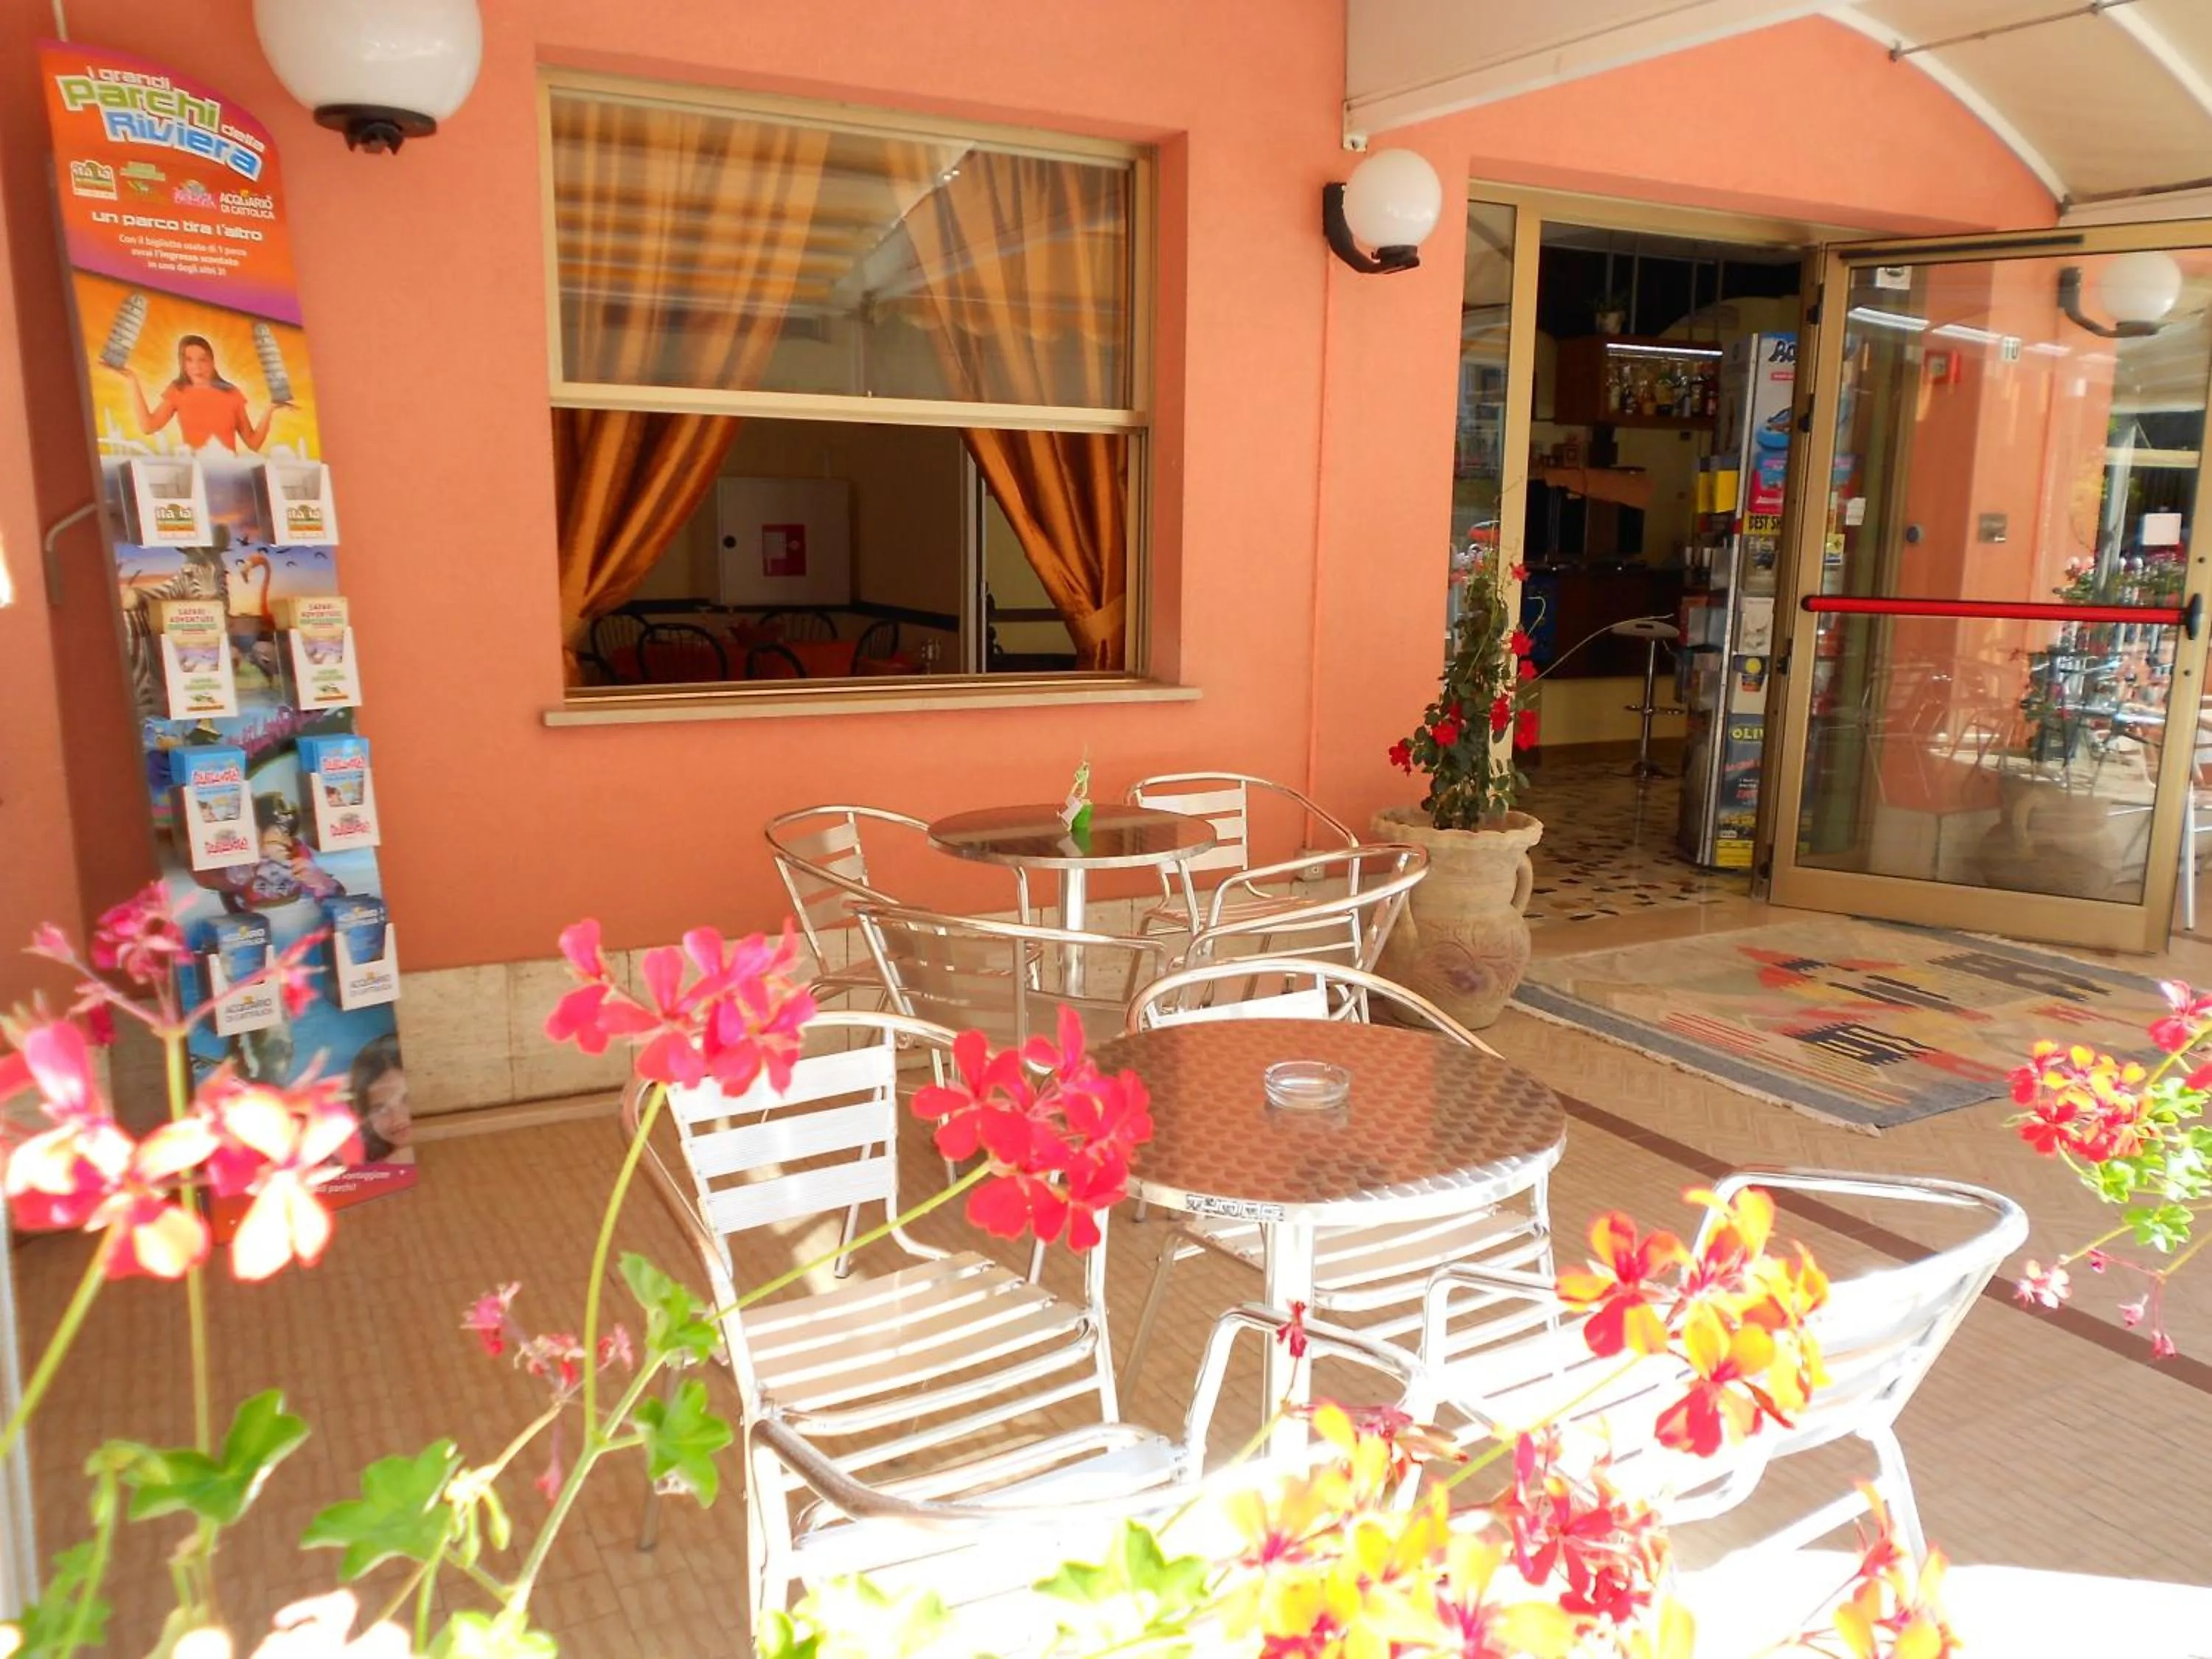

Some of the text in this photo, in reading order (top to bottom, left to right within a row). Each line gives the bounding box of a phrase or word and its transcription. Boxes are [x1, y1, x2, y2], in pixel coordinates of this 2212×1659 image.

[103, 110, 263, 182] Riviera
[91, 211, 118, 223] un
[122, 214, 180, 232] parco
